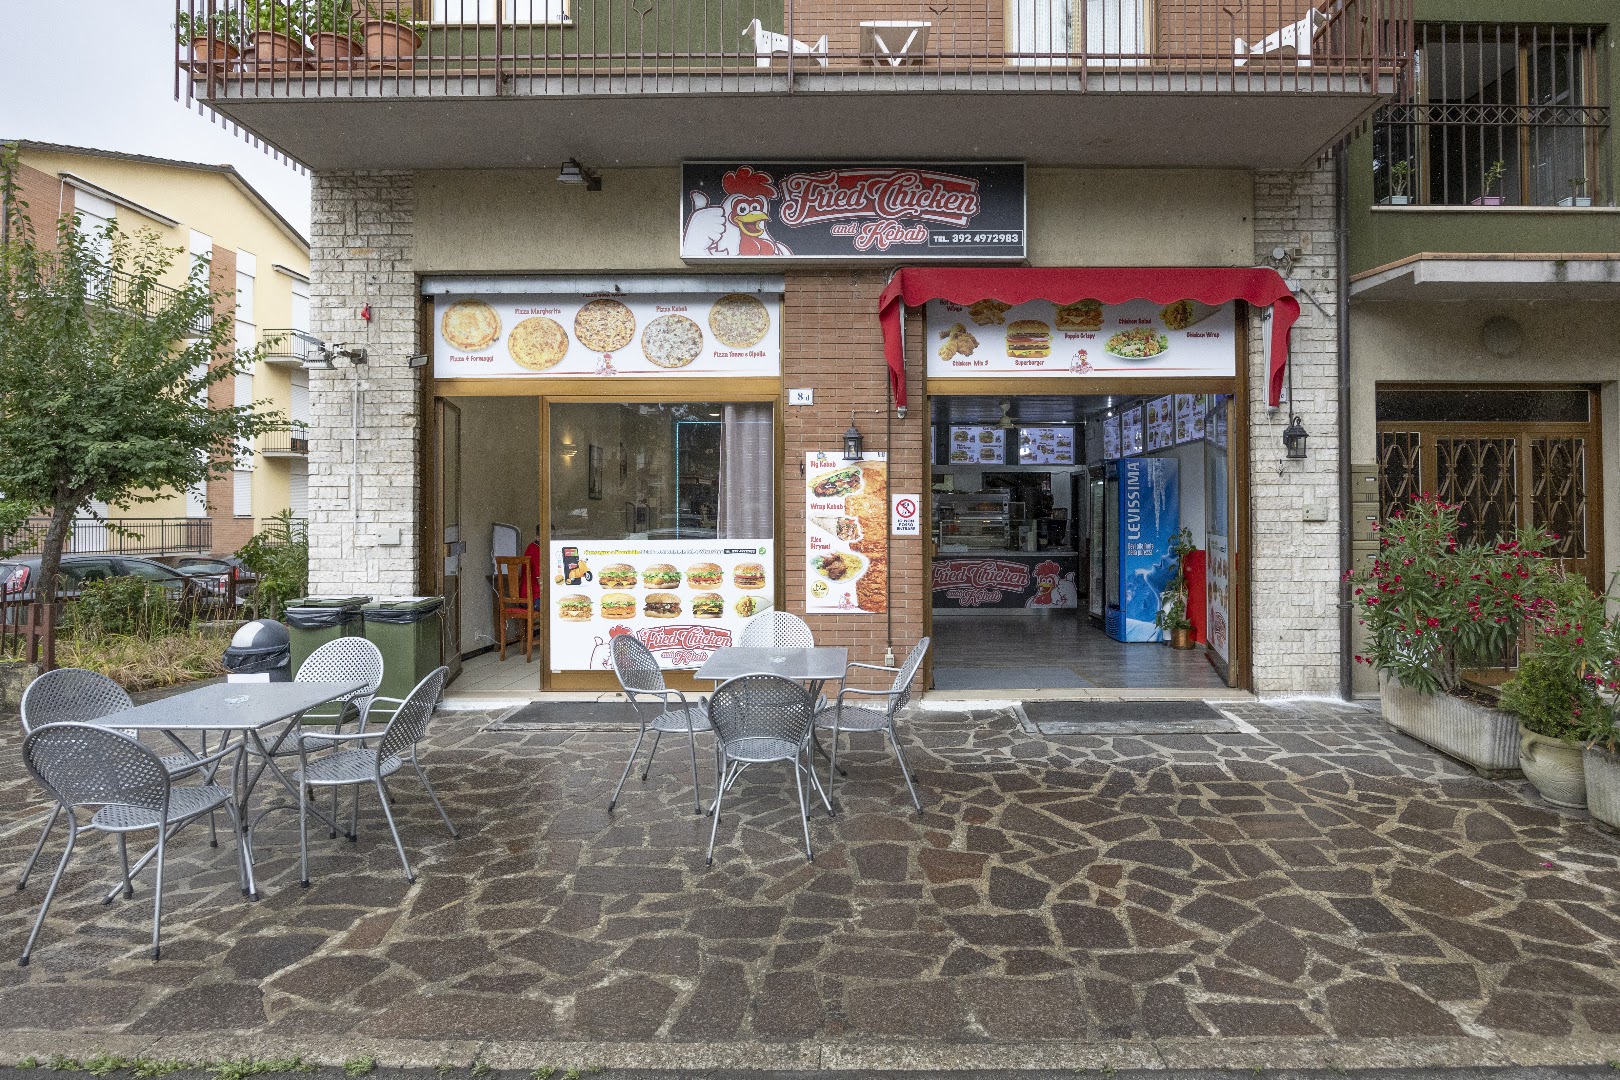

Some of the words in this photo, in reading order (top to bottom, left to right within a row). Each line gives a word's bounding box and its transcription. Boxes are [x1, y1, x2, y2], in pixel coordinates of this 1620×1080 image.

[780, 173, 869, 225] Fried
[868, 172, 980, 217] Chicken
[831, 222, 857, 236] and
[854, 220, 928, 251] Kebab
[933, 235, 950, 243] TEL.
[952, 233, 971, 243] 392
[973, 233, 1019, 243] 4972983
[713, 350, 729, 358] Pizza
[797, 392, 804, 401] 8
[810, 502, 826, 511] Wrap
[1127, 461, 1141, 540] LEVISSIMA
[966, 560, 1031, 588] Chicken
[958, 588, 1003, 607] Kebab
[641, 627, 679, 649] Fried
[677, 625, 733, 649] Chicken
[672, 649, 709, 666] Kebab
